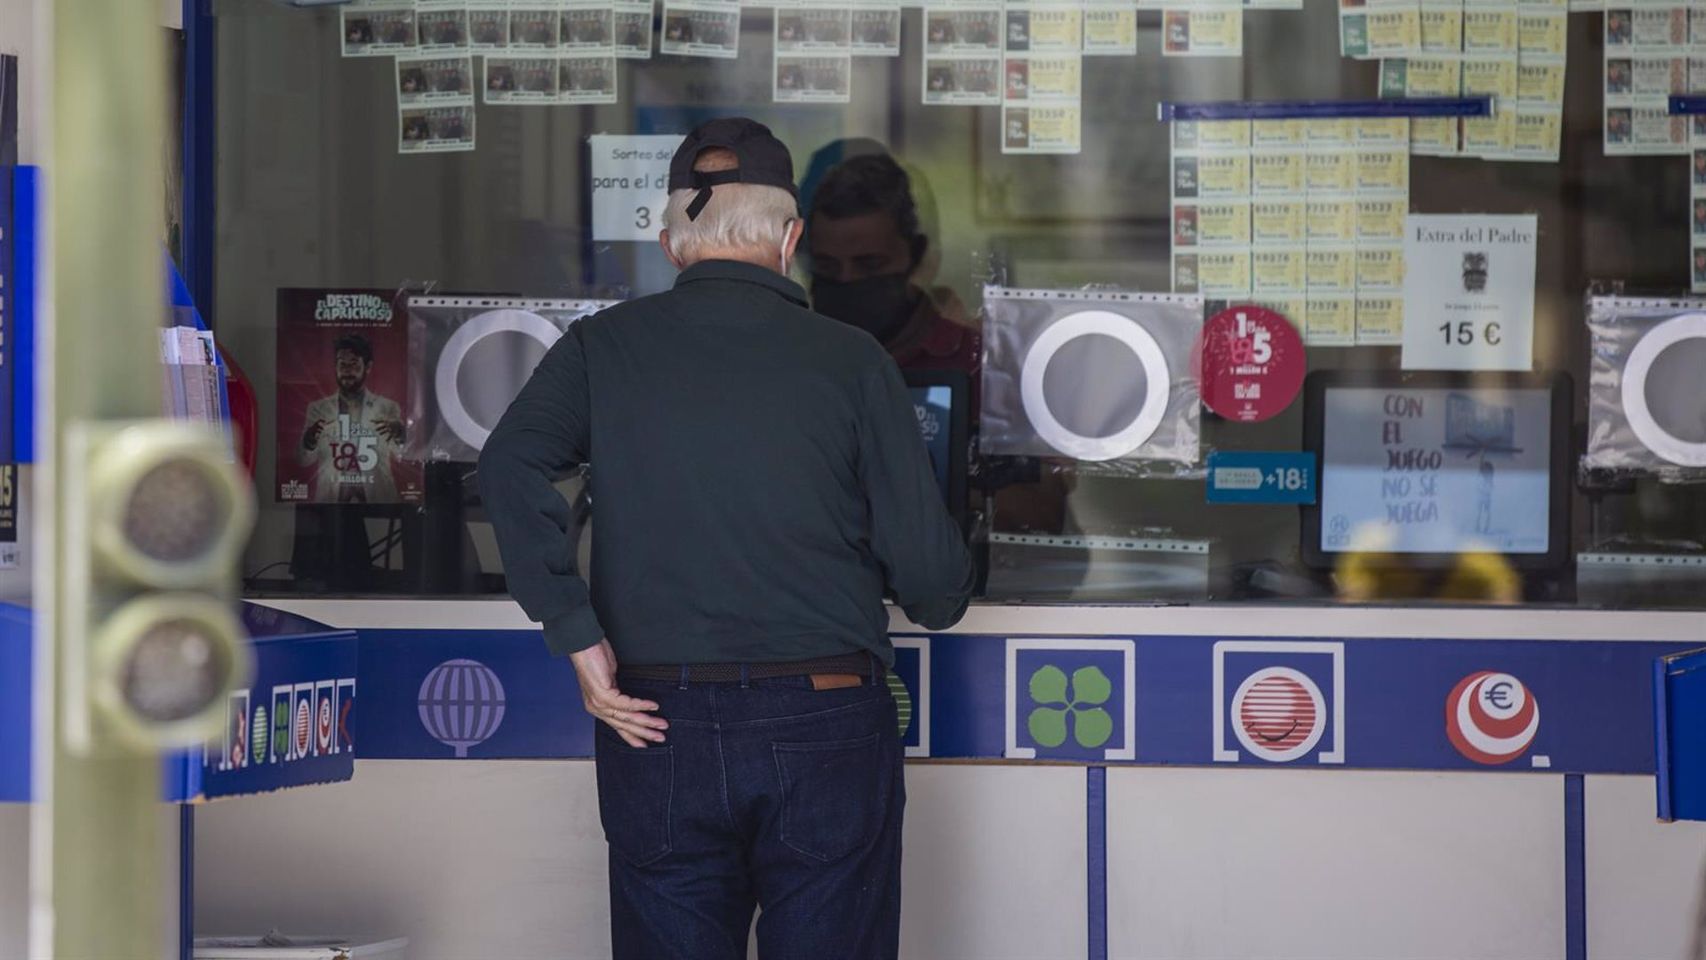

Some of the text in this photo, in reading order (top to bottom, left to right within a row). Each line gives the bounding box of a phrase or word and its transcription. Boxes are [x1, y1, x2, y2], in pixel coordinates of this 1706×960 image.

[612, 148, 653, 160] Sorteo
[593, 177, 629, 193] para
[634, 174, 649, 189] el
[635, 206, 651, 229] 3
[1416, 227, 1533, 243] Extra del Padre
[326, 294, 381, 309] DESTINO
[315, 307, 393, 322] CAPRICHOSO
[1235, 313, 1247, 338] 1
[1439, 321, 1502, 345] 15 €
[1253, 332, 1272, 365] 5
[1383, 394, 1424, 419] CON
[338, 414, 350, 441] 1
[1382, 420, 1403, 445] EL
[357, 437, 378, 471] 5
[1382, 448, 1443, 472] JUEGO
[1265, 467, 1301, 491] +18
[1381, 474, 1440, 498] NO SE
[1382, 500, 1440, 526] JUEGA
